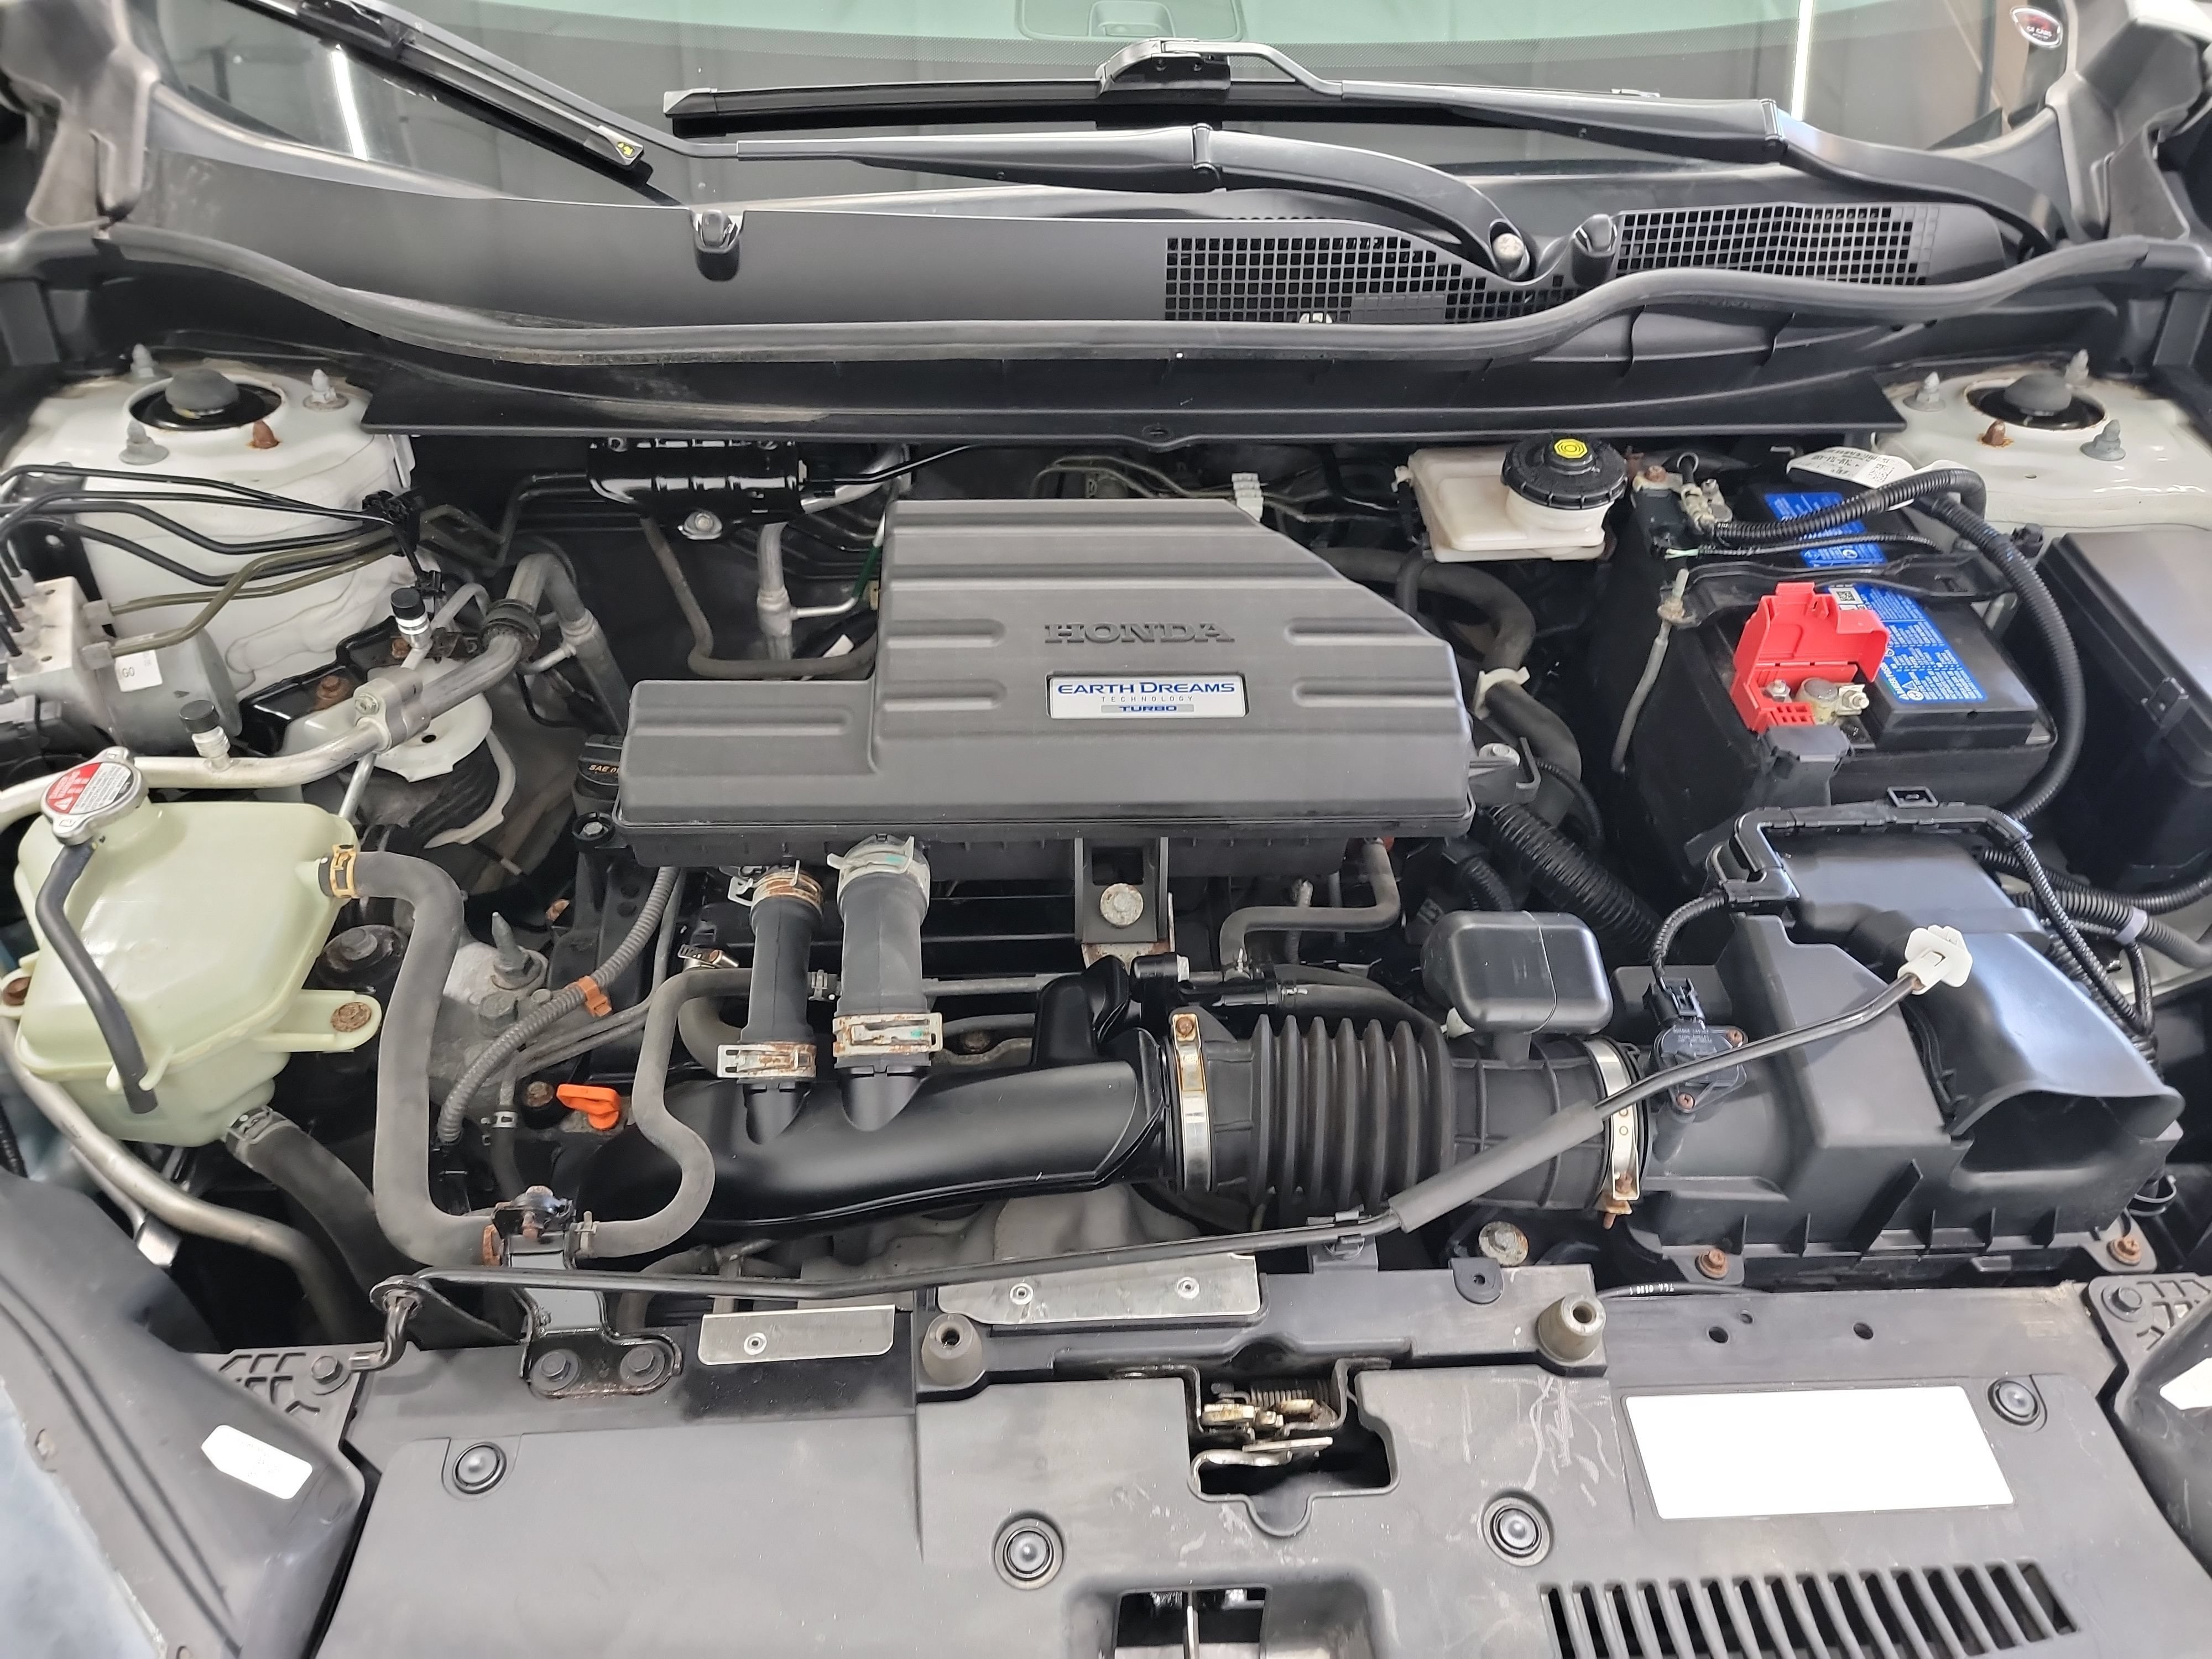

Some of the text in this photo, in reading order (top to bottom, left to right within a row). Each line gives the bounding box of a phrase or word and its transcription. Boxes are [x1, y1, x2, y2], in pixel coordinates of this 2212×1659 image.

[1045, 622, 1235, 643] HONDA
[1058, 681, 1235, 695] EARTH DREAMS
[588, 764, 610, 773] SAE
